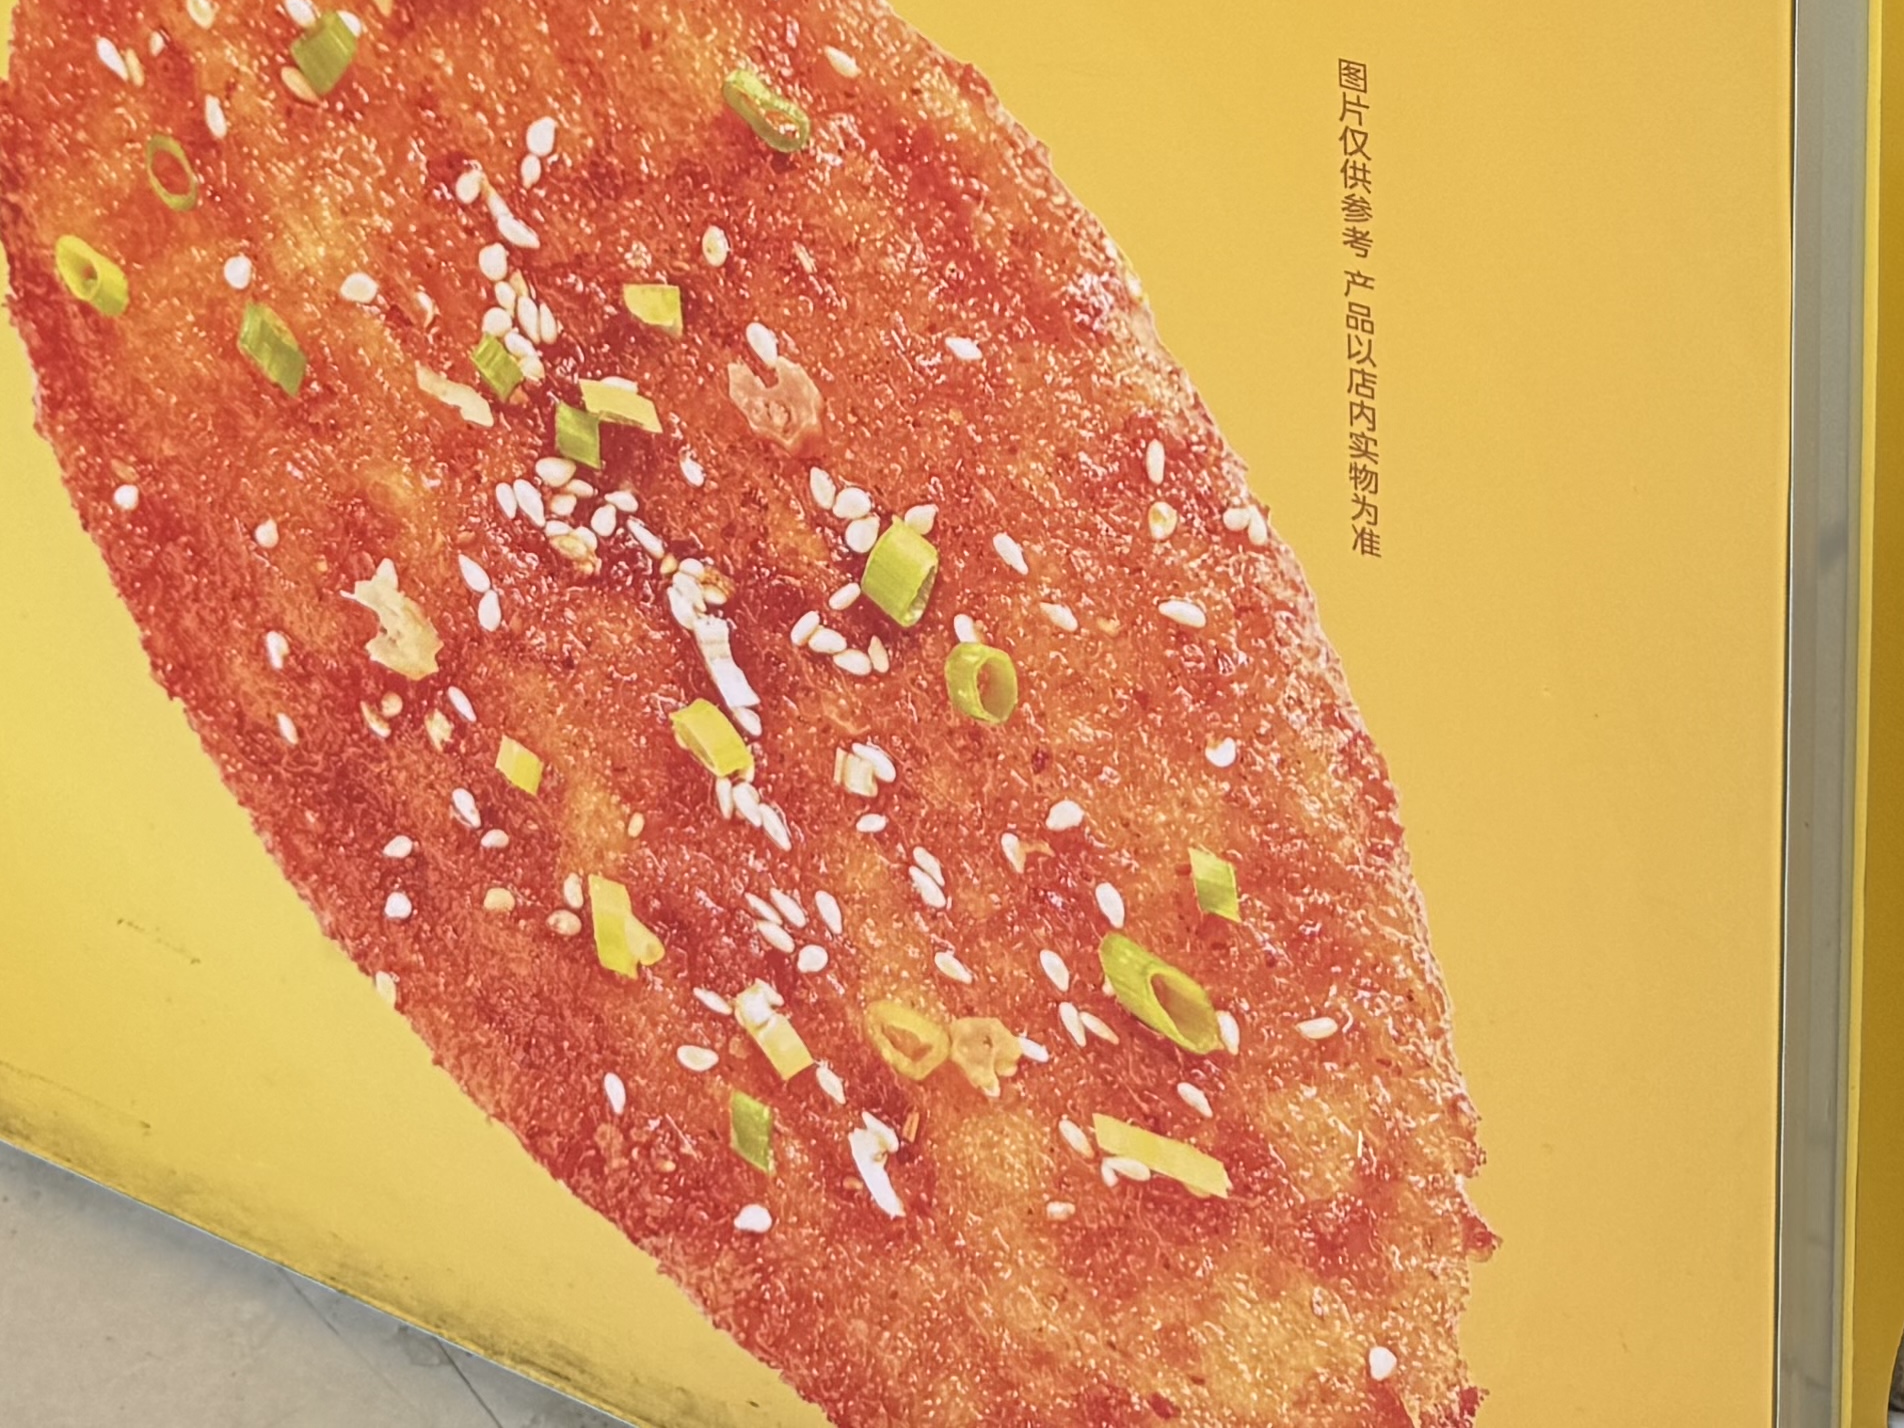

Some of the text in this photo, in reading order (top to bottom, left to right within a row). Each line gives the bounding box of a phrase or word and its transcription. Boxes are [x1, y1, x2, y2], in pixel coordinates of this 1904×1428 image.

[1338, 58, 1382, 559] 图片仅供参考 产品以店内实物为准
